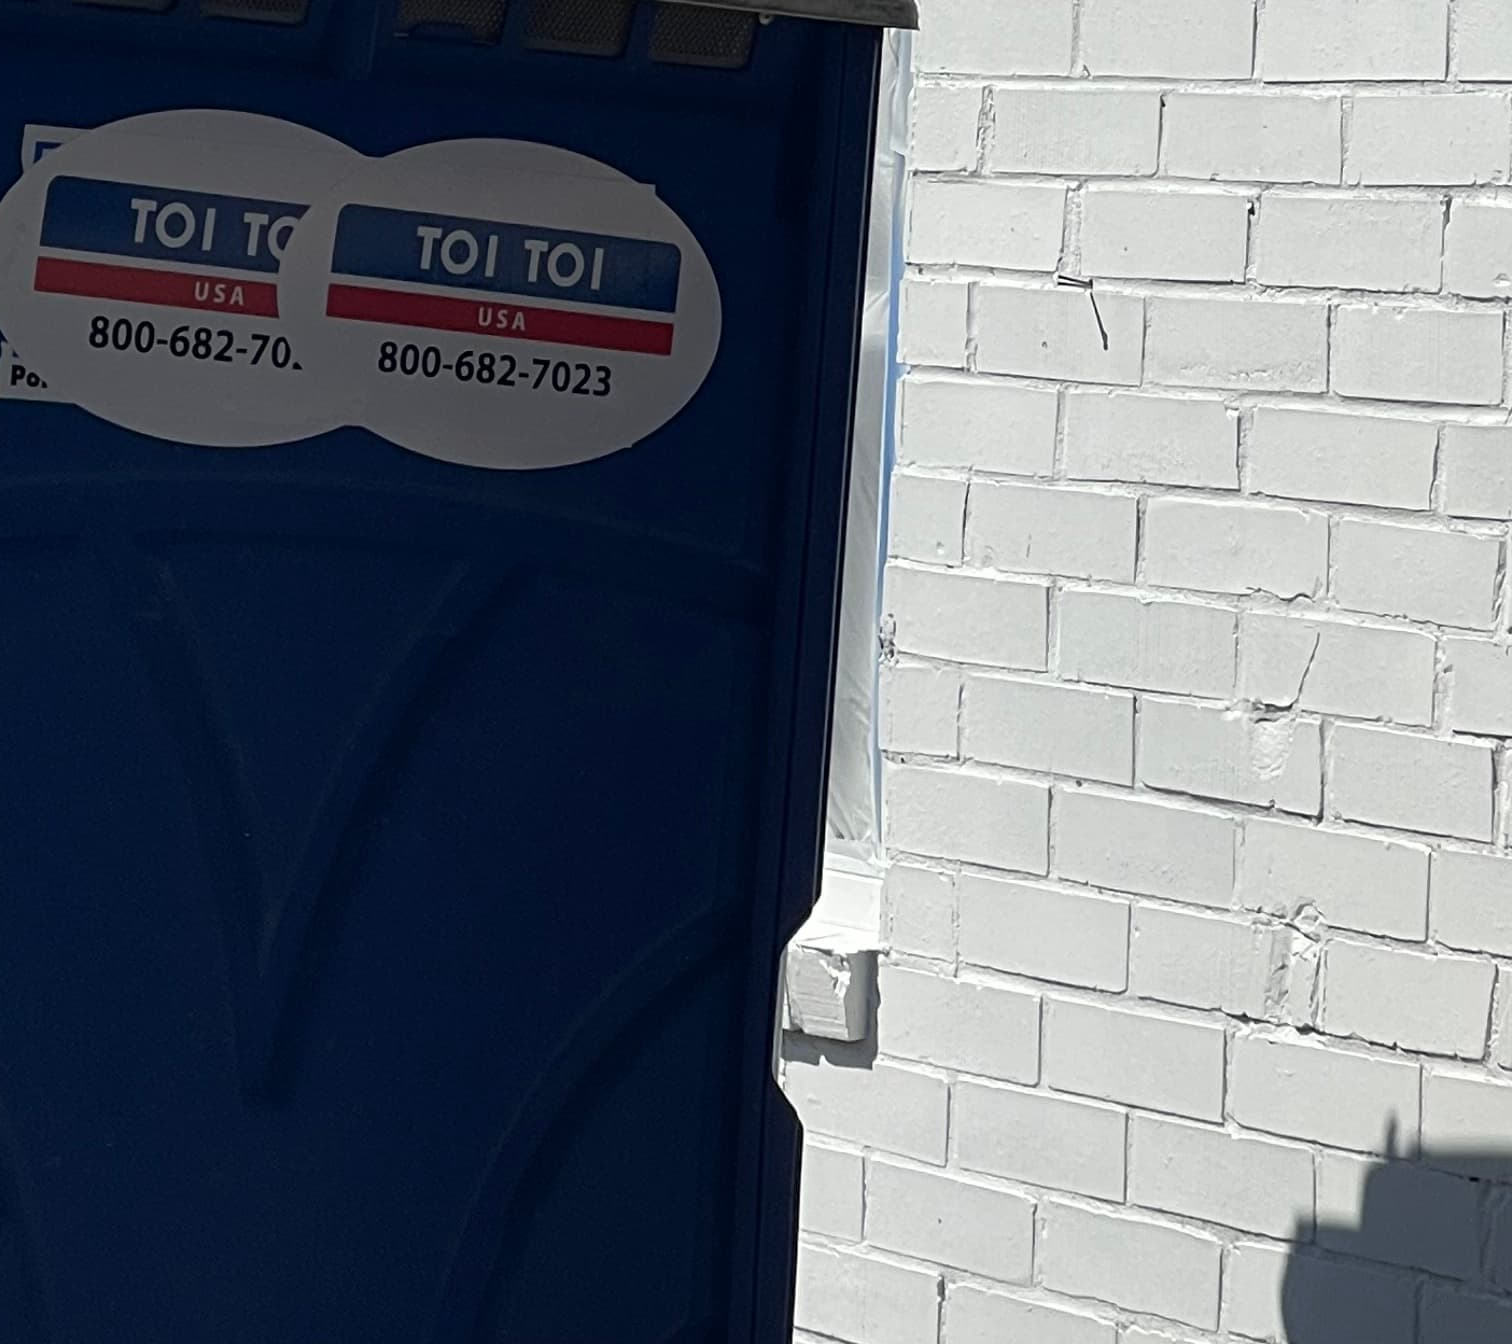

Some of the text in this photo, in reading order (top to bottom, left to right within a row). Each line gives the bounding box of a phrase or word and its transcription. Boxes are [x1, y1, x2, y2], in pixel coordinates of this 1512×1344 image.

[130, 197, 217, 252] TOI
[416, 225, 605, 291] TOI TOI
[193, 280, 246, 307] USA
[477, 306, 527, 332] USA
[88, 315, 304, 371] 800-682-70
[377, 340, 613, 397] 800-682-7023
[10, 363, 49, 389] Po
